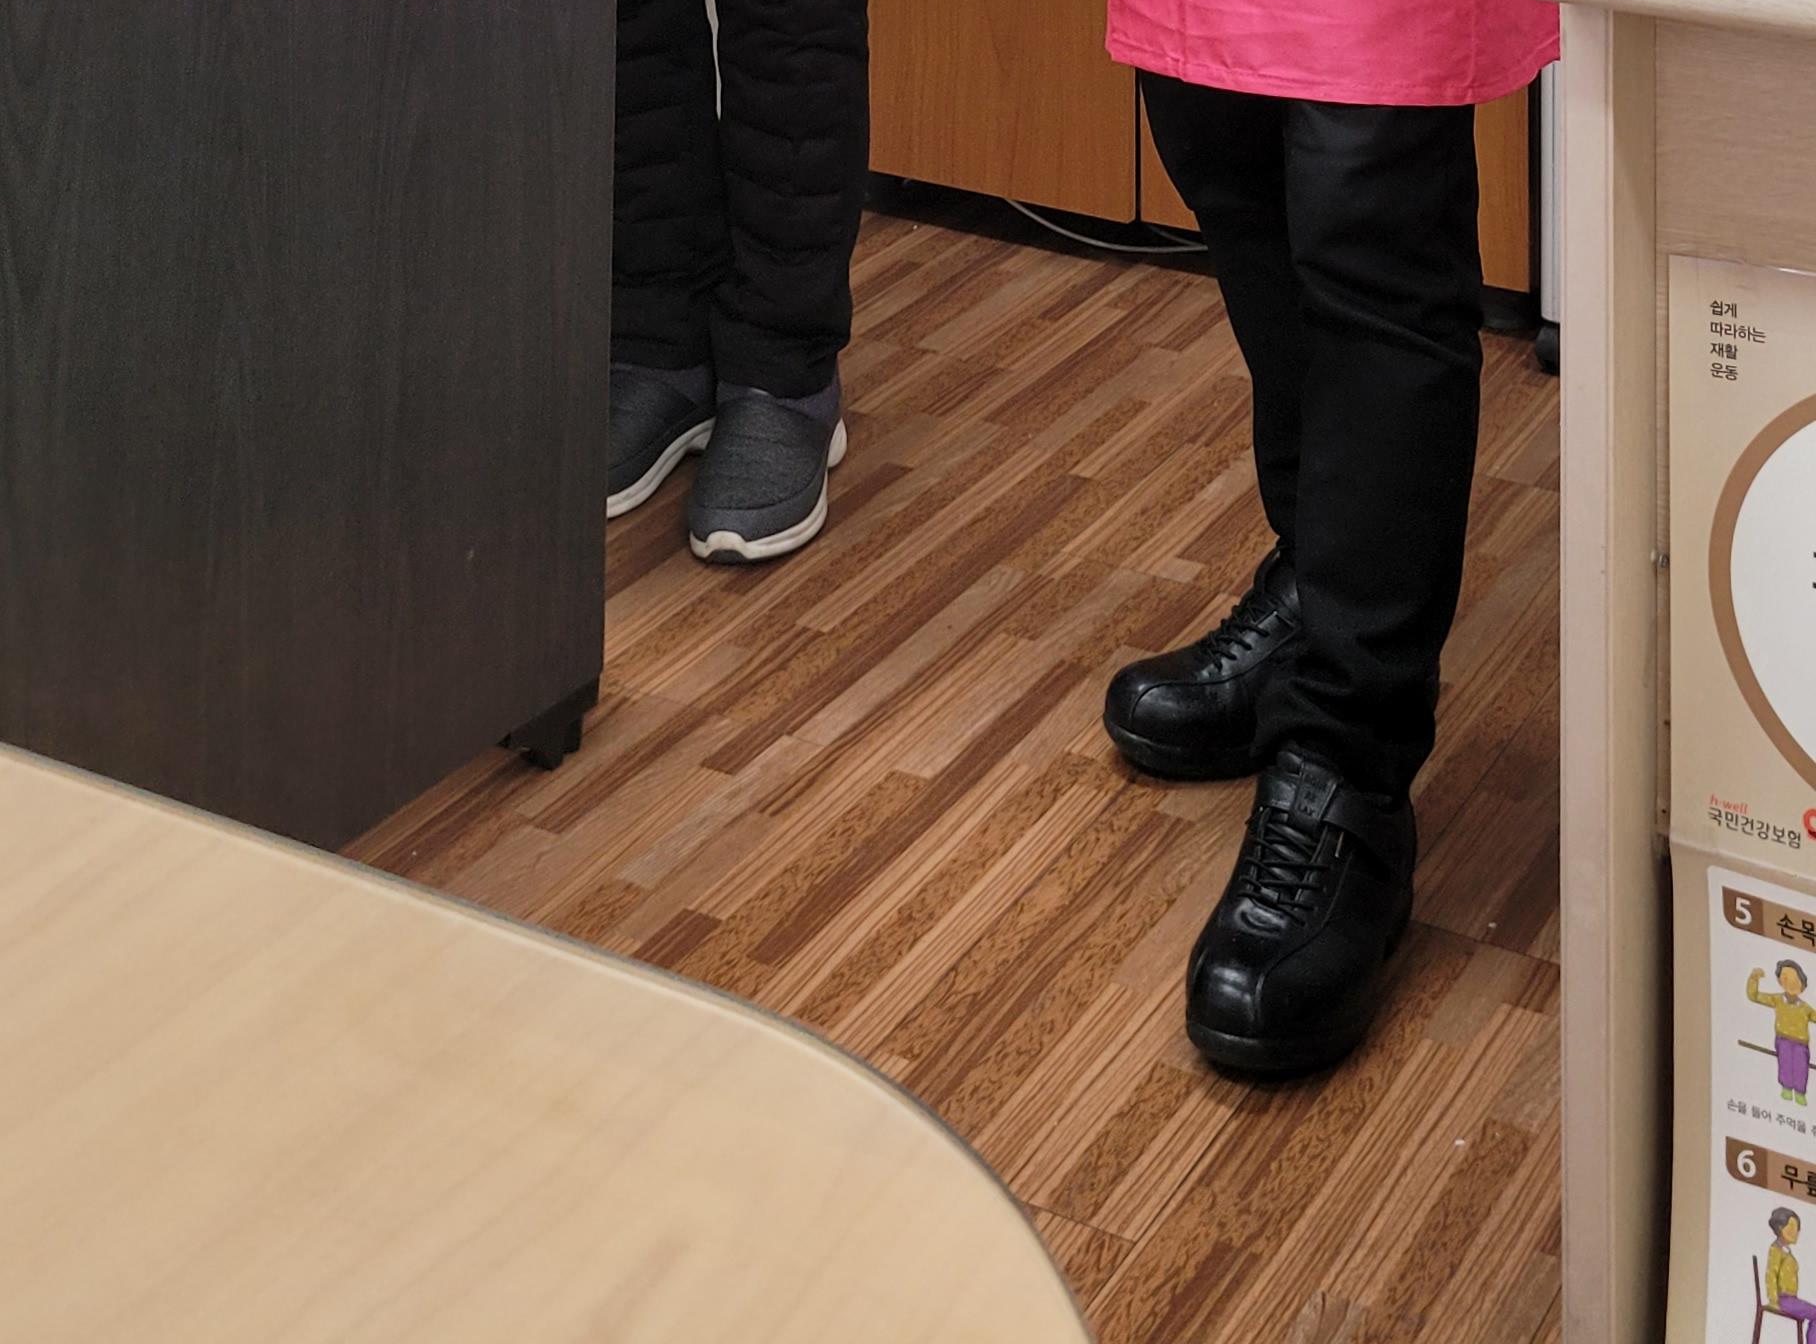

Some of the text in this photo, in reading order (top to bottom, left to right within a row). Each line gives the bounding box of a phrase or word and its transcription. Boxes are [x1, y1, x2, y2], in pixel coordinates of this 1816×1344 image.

[1709, 299, 1738, 318] 쉽게
[1709, 321, 1767, 344] 따라하는
[1709, 342, 1739, 360] 재활
[1709, 362, 1739, 381] 운동
[1708, 807, 1801, 849] 국민건강보험
[1735, 897, 1752, 925] 5
[1737, 1150, 1757, 1178] 6
